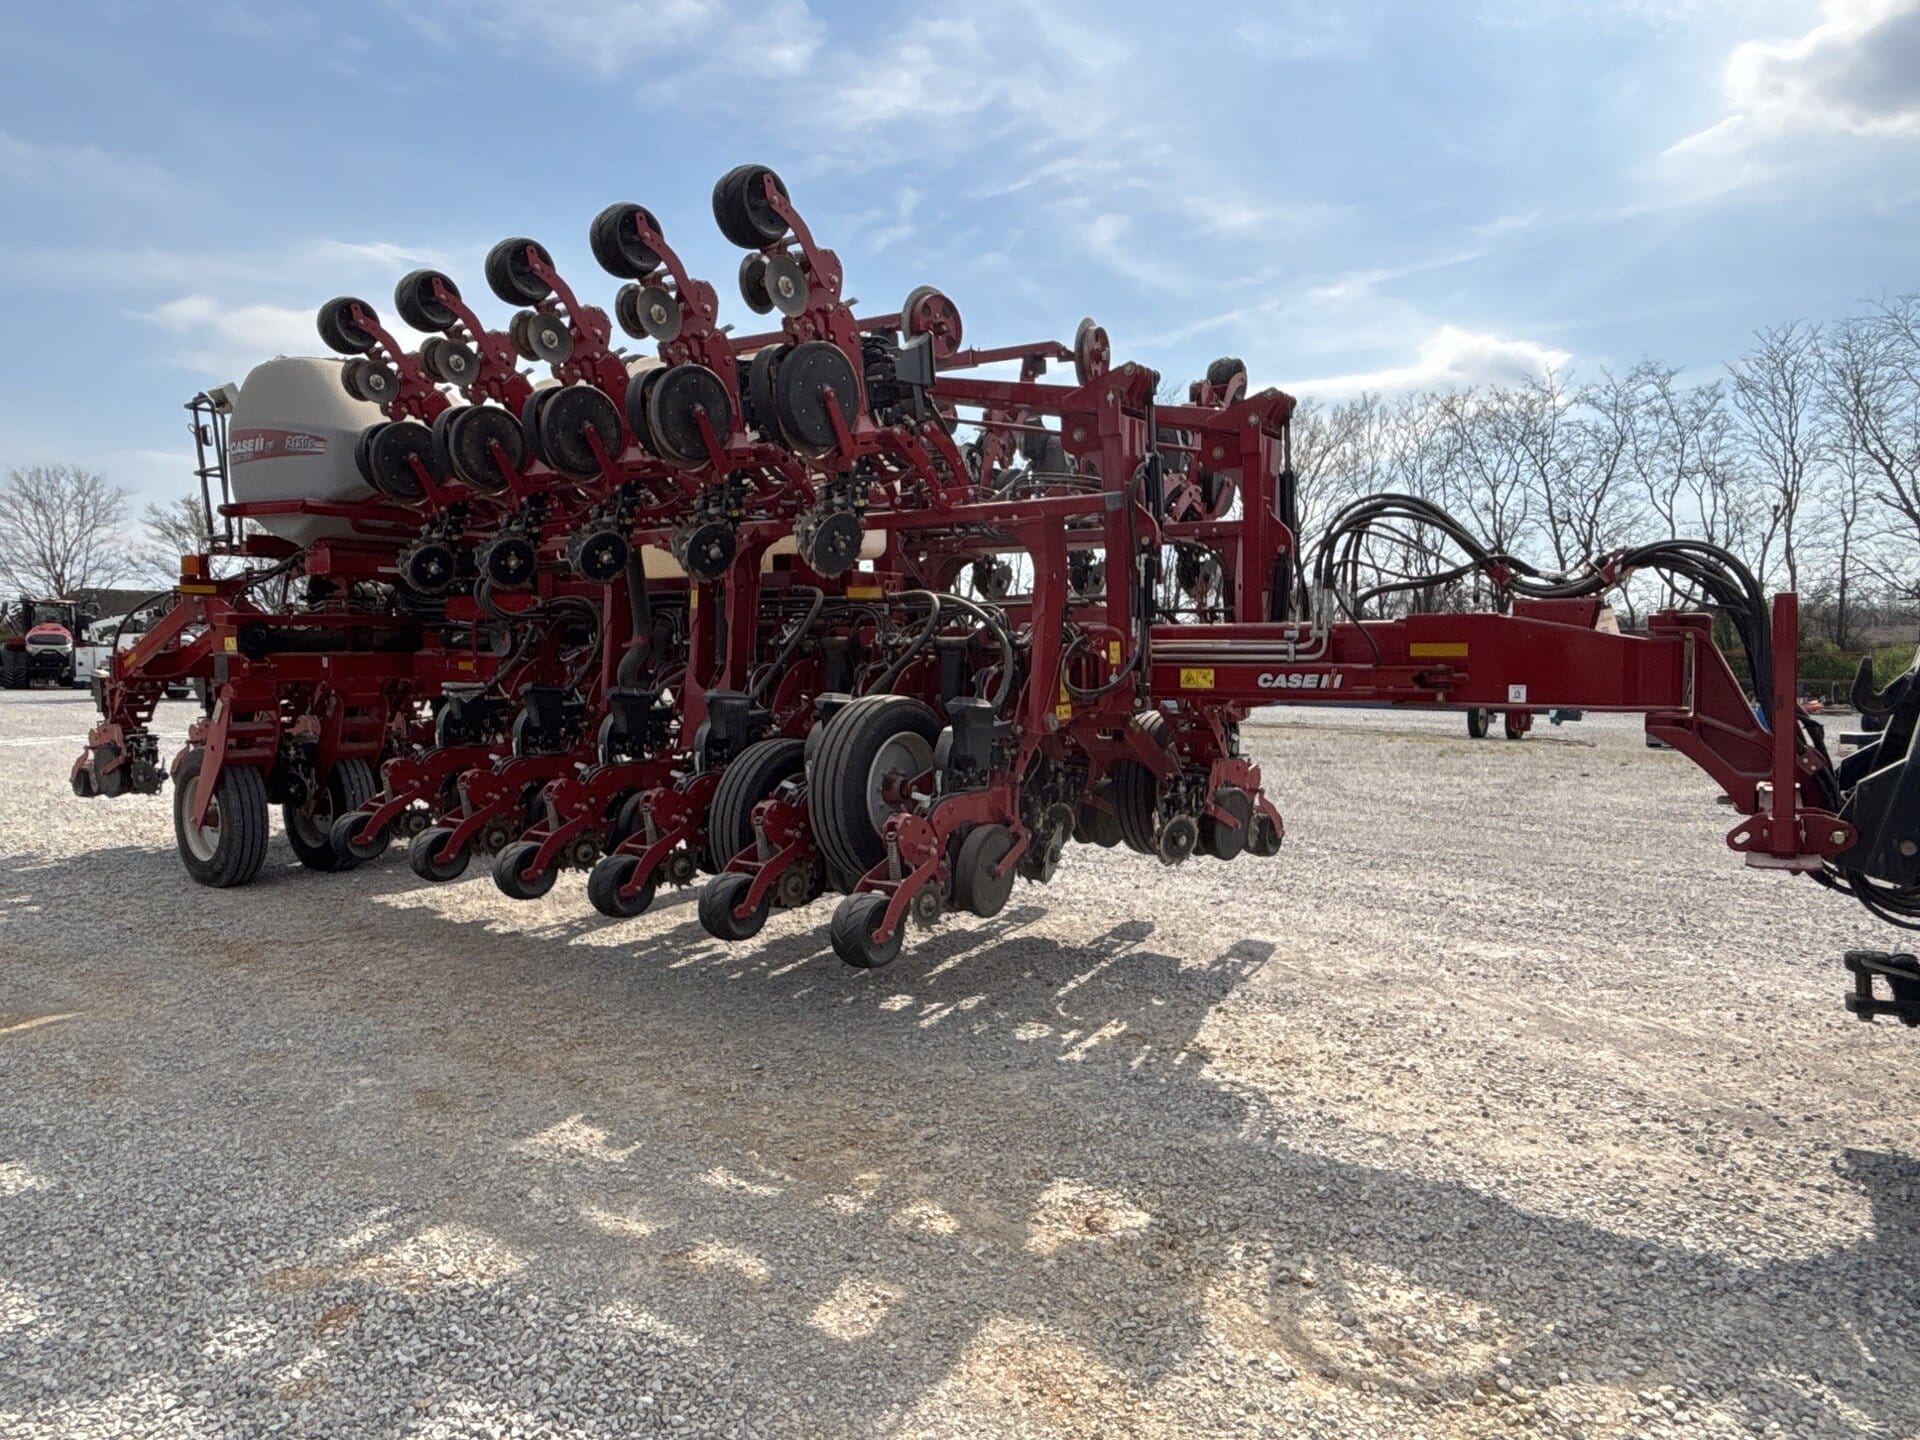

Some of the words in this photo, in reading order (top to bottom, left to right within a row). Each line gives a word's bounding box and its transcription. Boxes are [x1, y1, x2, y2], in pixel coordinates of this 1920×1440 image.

[230, 439, 254, 454] CASE
[1257, 673, 1319, 688] CASE
[1319, 667, 1343, 688] IH
